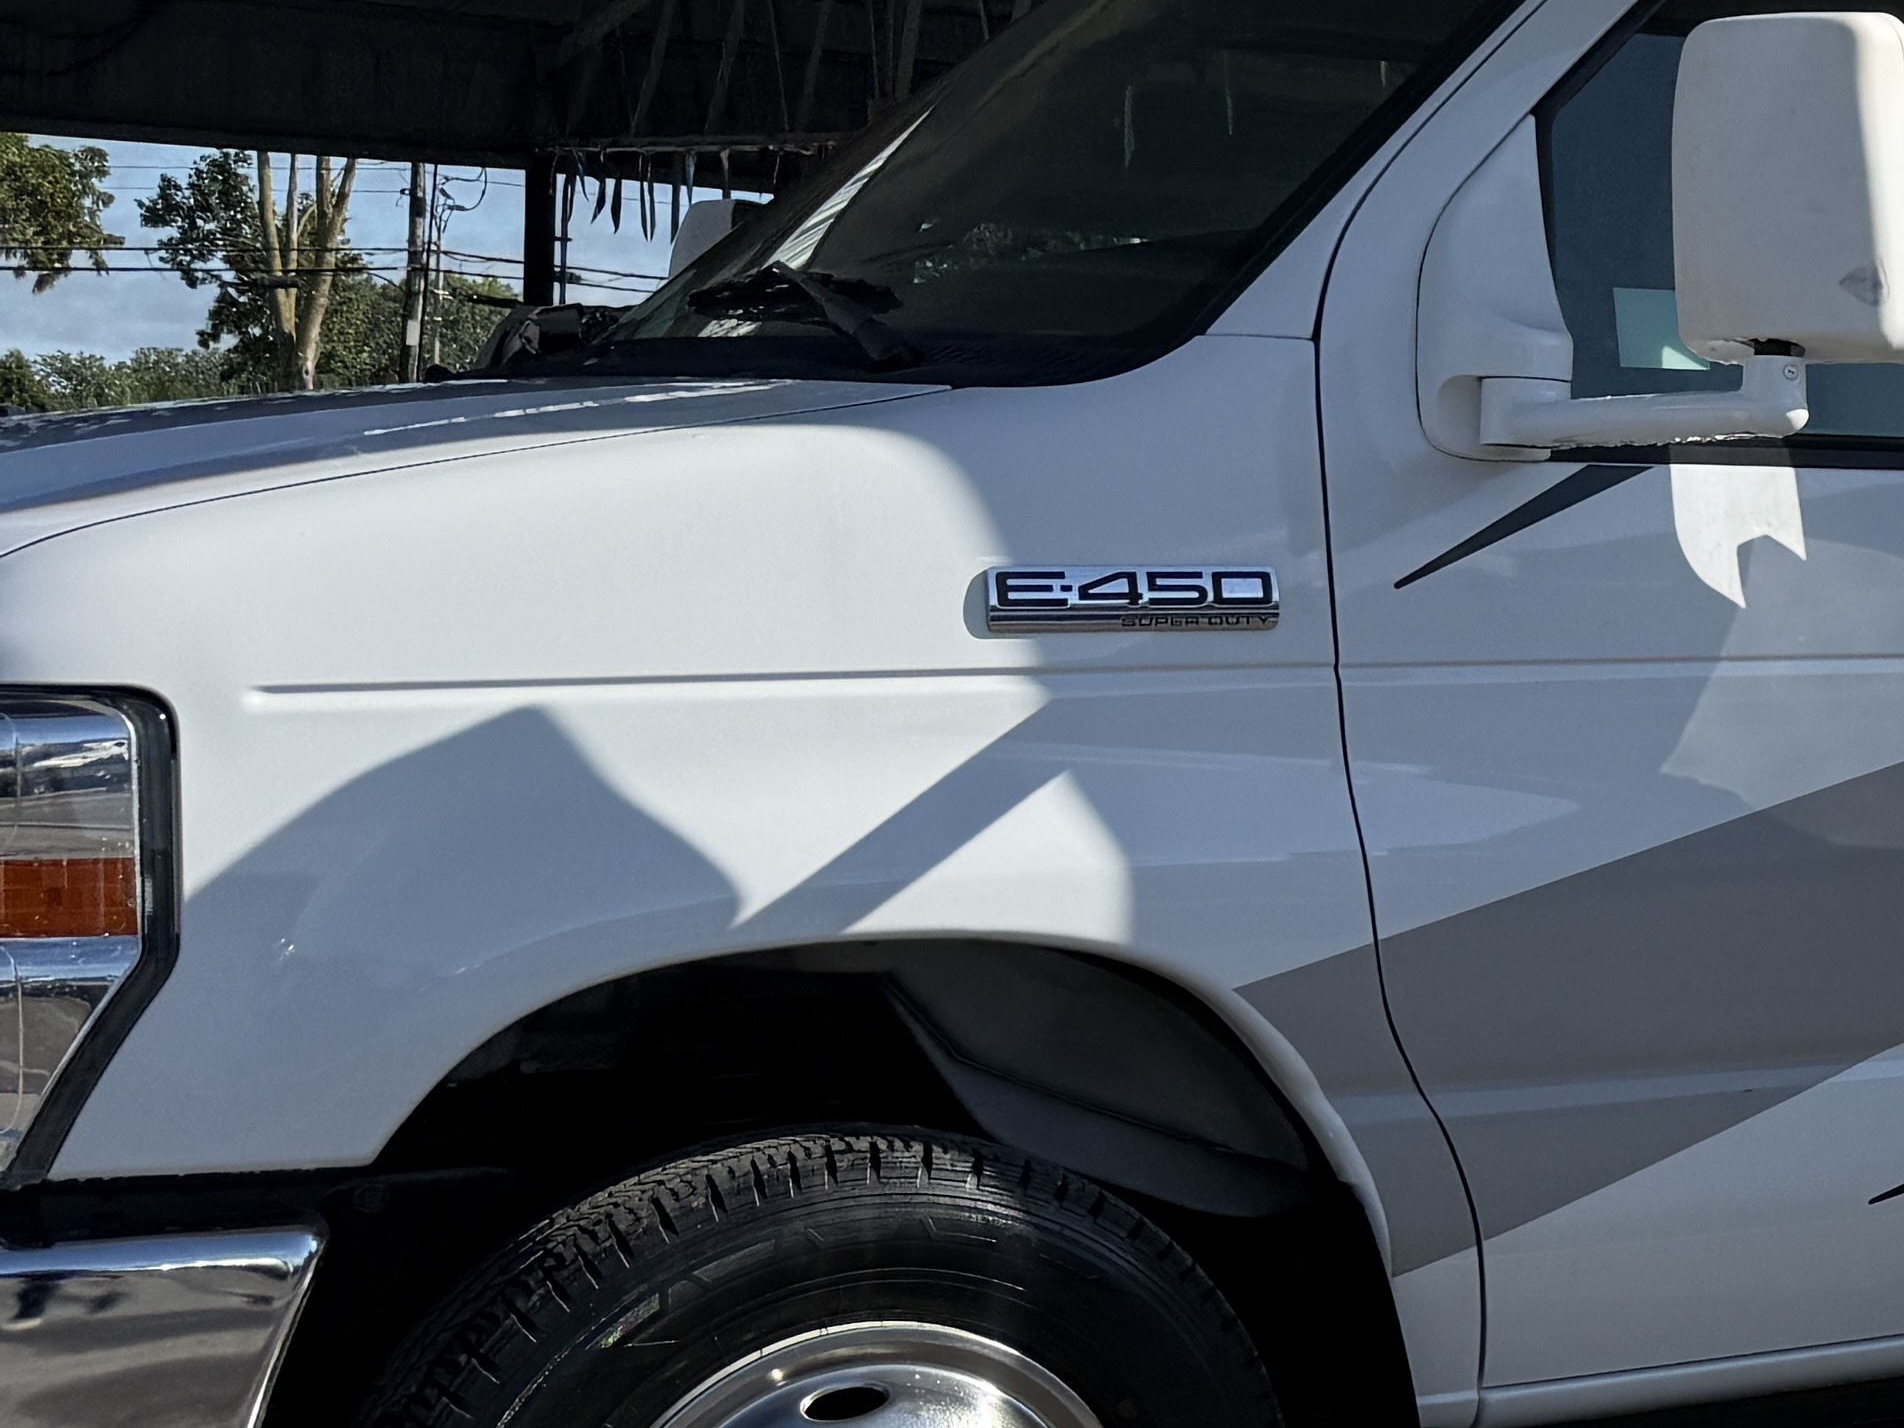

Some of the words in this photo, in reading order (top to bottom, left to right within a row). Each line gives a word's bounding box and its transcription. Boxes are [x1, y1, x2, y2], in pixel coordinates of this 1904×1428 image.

[994, 569, 1274, 608] E-450
[1120, 615, 1200, 628] SUPER
[1207, 614, 1270, 627] DUTY
